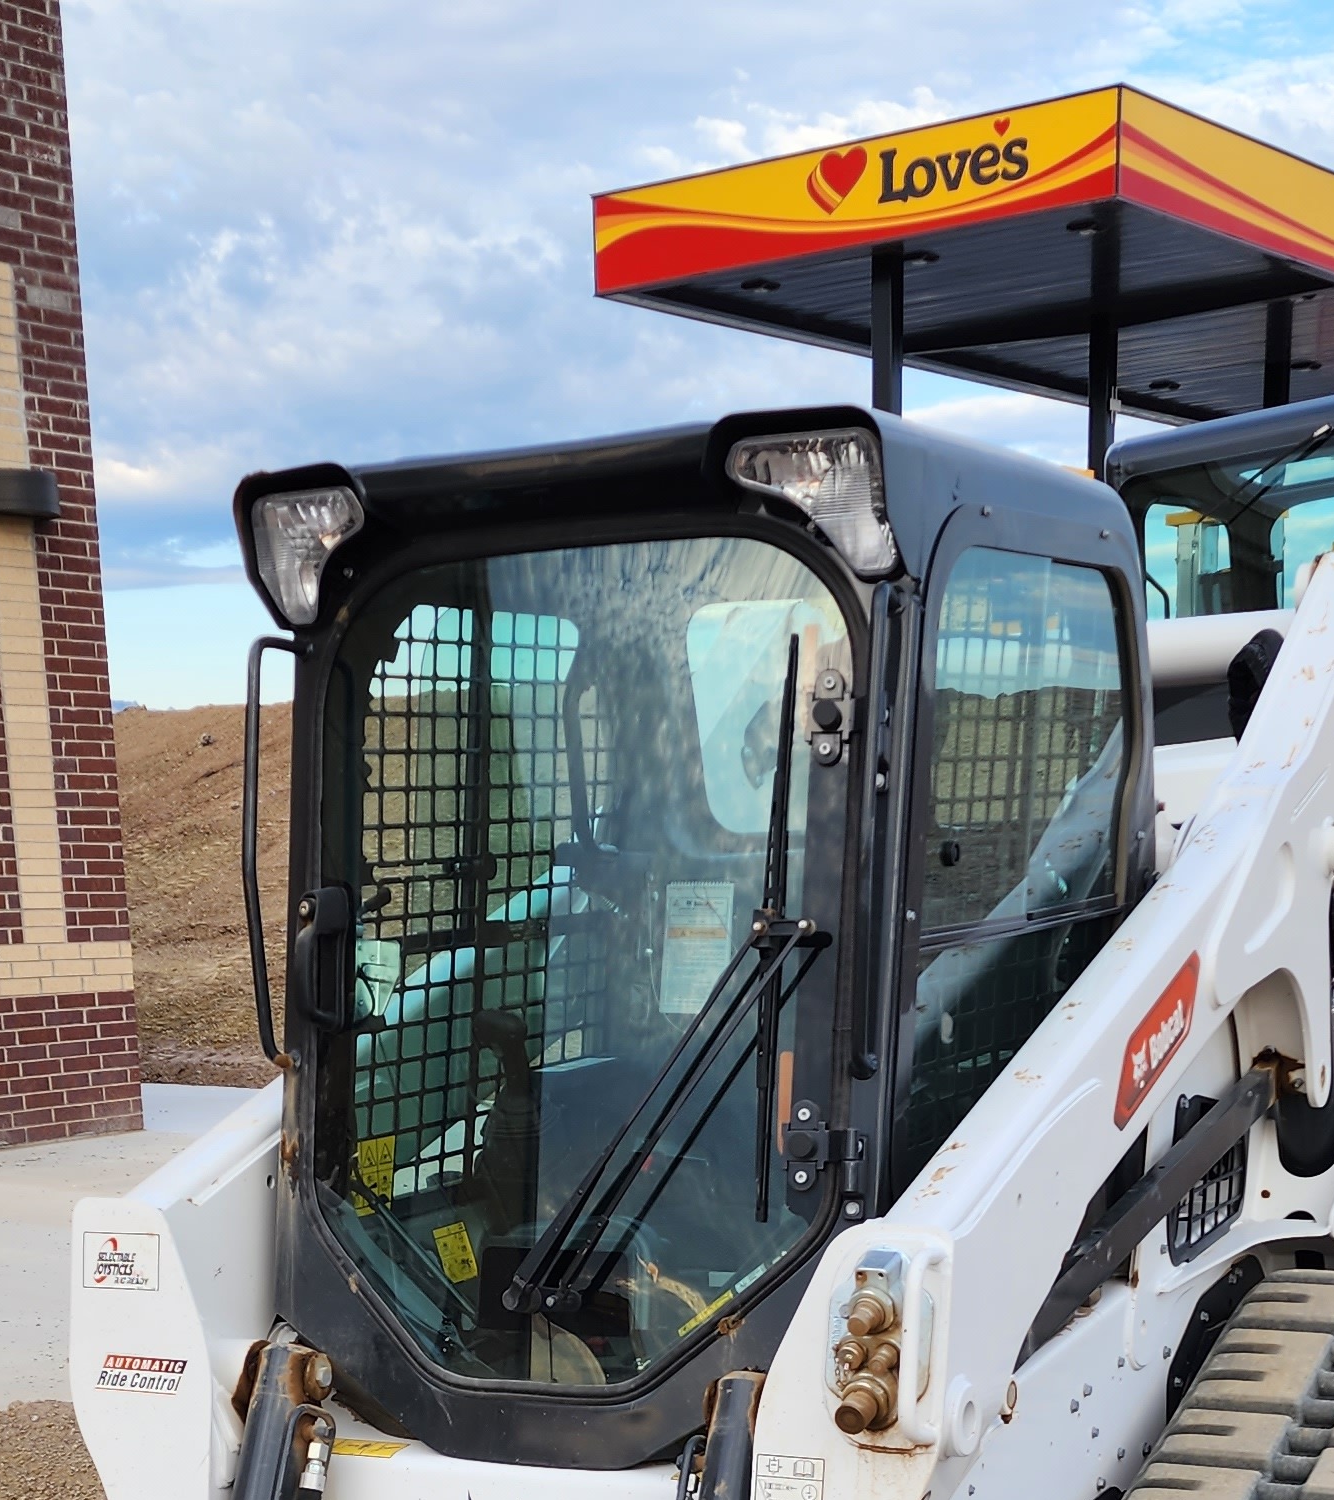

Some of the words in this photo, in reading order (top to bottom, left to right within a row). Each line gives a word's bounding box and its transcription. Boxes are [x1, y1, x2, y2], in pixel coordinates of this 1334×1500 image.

[1149, 999, 1184, 1069] Bobcat
[106, 1356, 184, 1373] AUTOMATIC
[97, 1370, 127, 1386] Ride
[130, 1373, 182, 1391] Control
